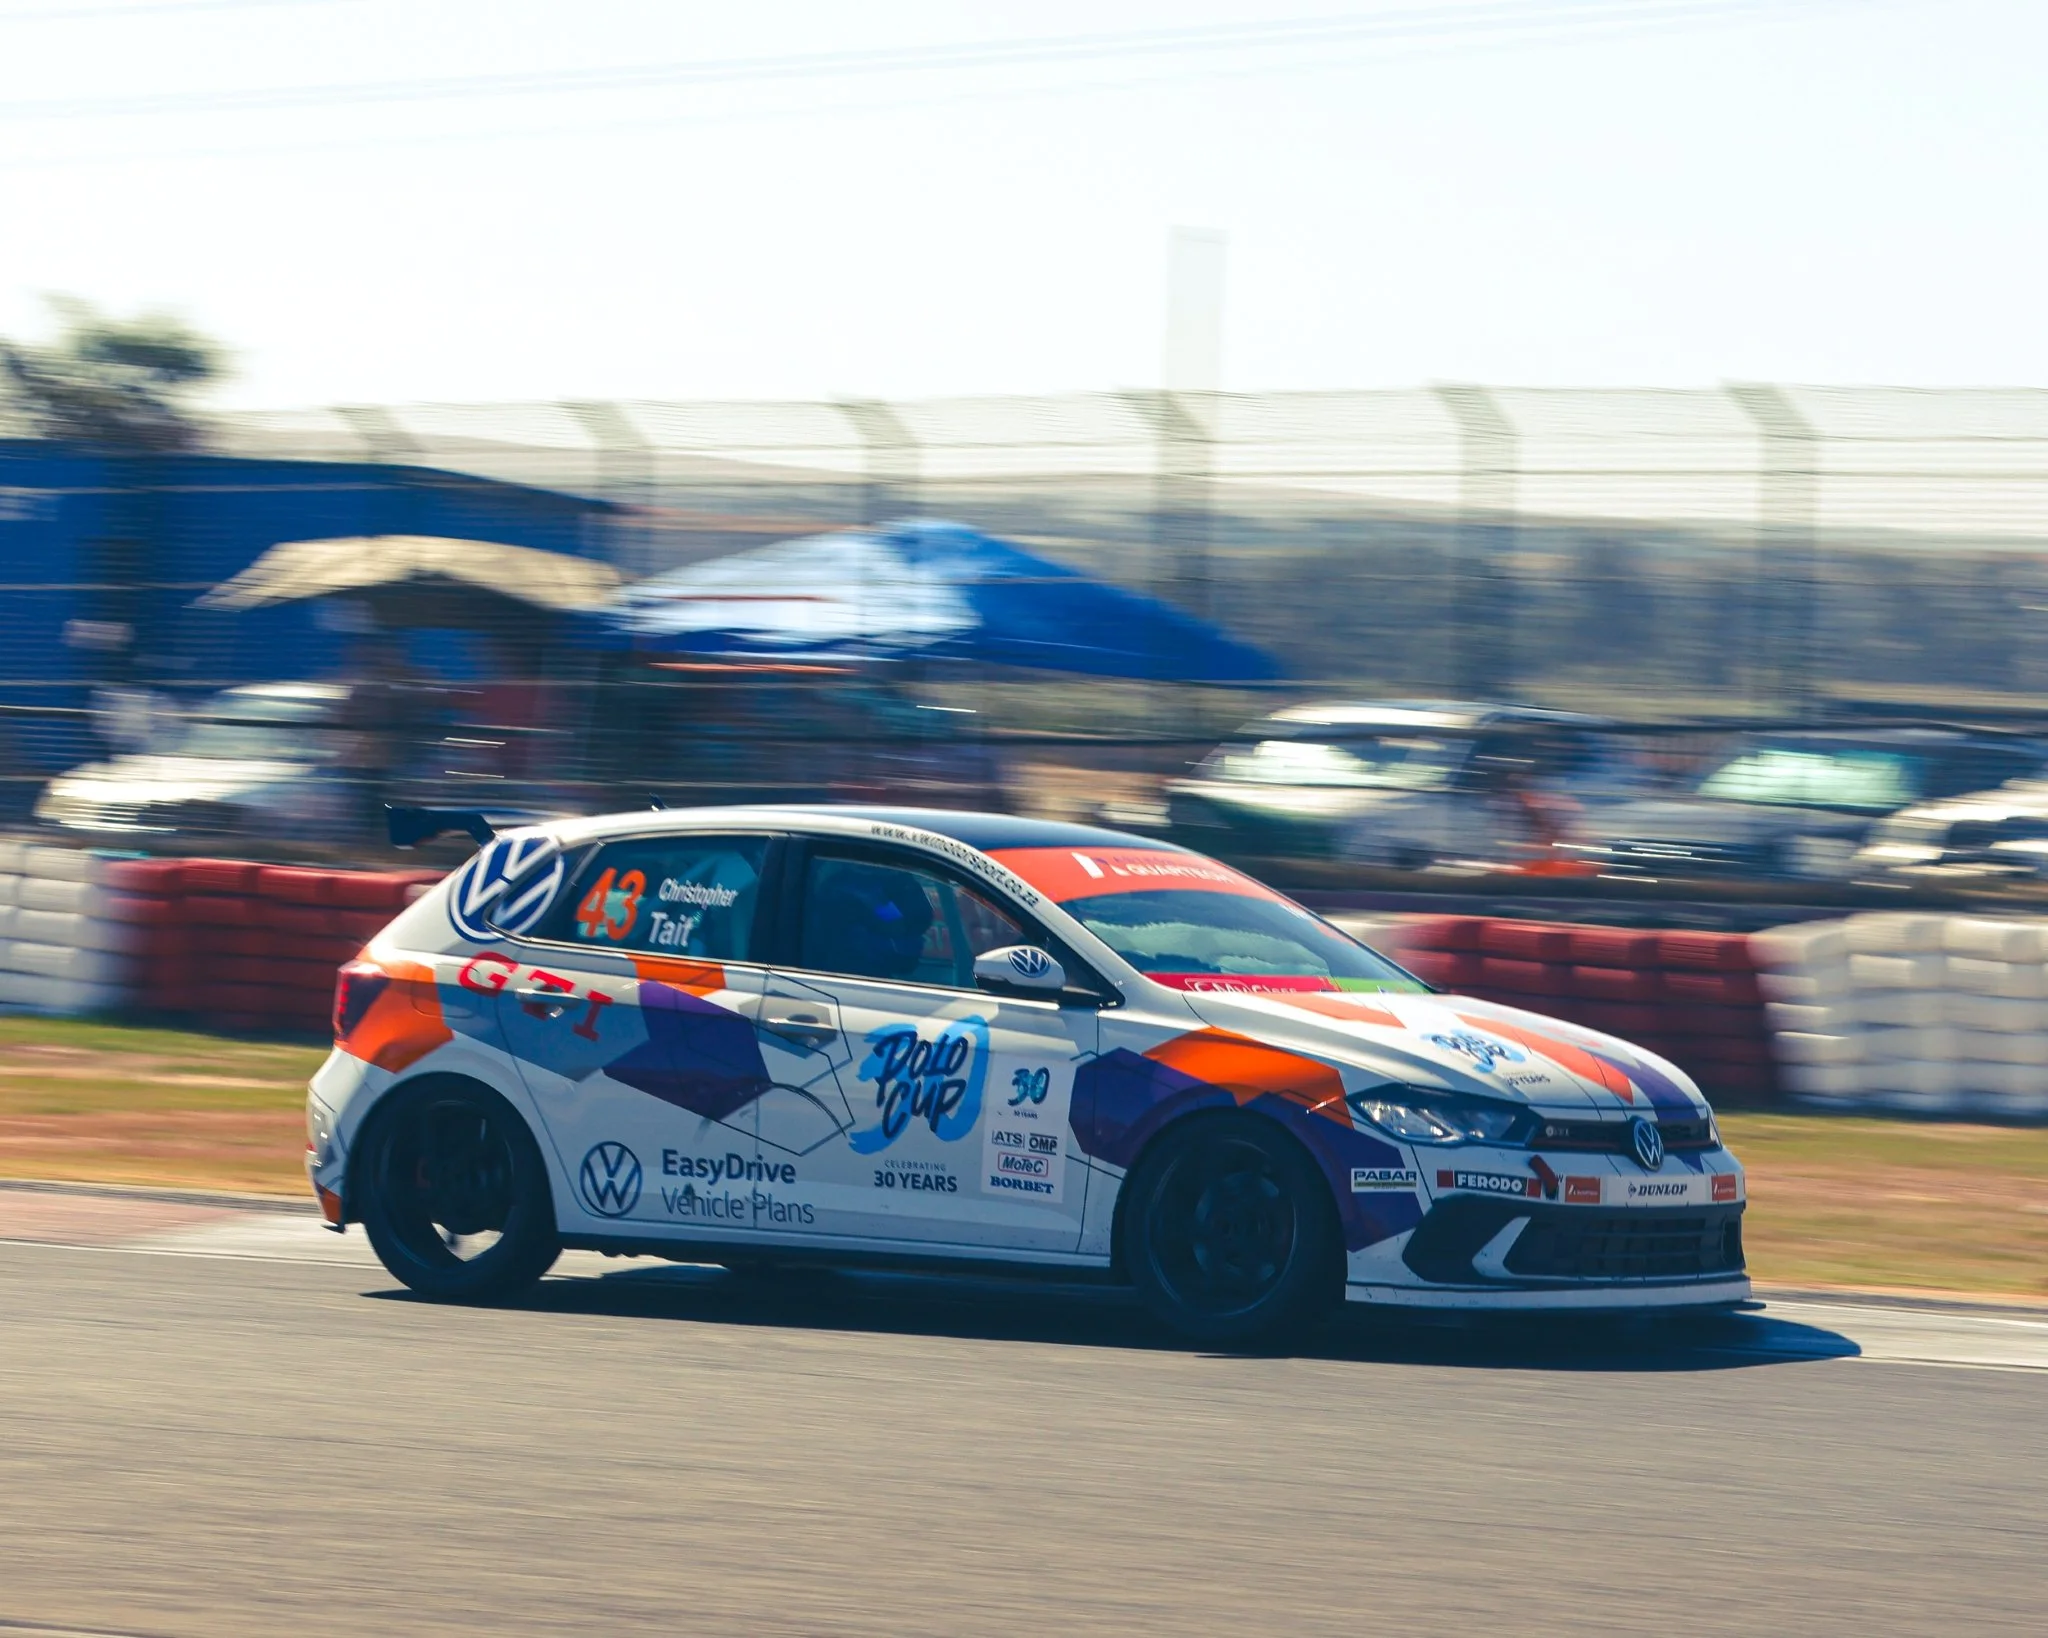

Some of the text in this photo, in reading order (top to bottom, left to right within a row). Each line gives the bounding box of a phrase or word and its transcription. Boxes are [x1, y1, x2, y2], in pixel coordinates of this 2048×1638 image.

[576, 867, 647, 941] 43
[658, 877, 739, 911] Christopher
[648, 911, 694, 948] Tait
[457, 952, 615, 1041] GTI
[1007, 1066, 1050, 1106] 30
[994, 1131, 1023, 1145] ATS
[1029, 1137, 1057, 1152] OMP
[662, 1149, 796, 1185] EasyDrive
[884, 1159, 947, 1172] CELEBRATING
[1002, 1156, 1044, 1173] MoTeC
[874, 1170, 958, 1193] 30 YEARS
[990, 1175, 1054, 1194] BORBET
[1354, 1170, 1417, 1181] PABAR
[1457, 1173, 1523, 1192] FERODO
[1637, 1184, 1688, 1197] DUNLOP
[661, 1186, 815, 1224] Vehicle Plans
